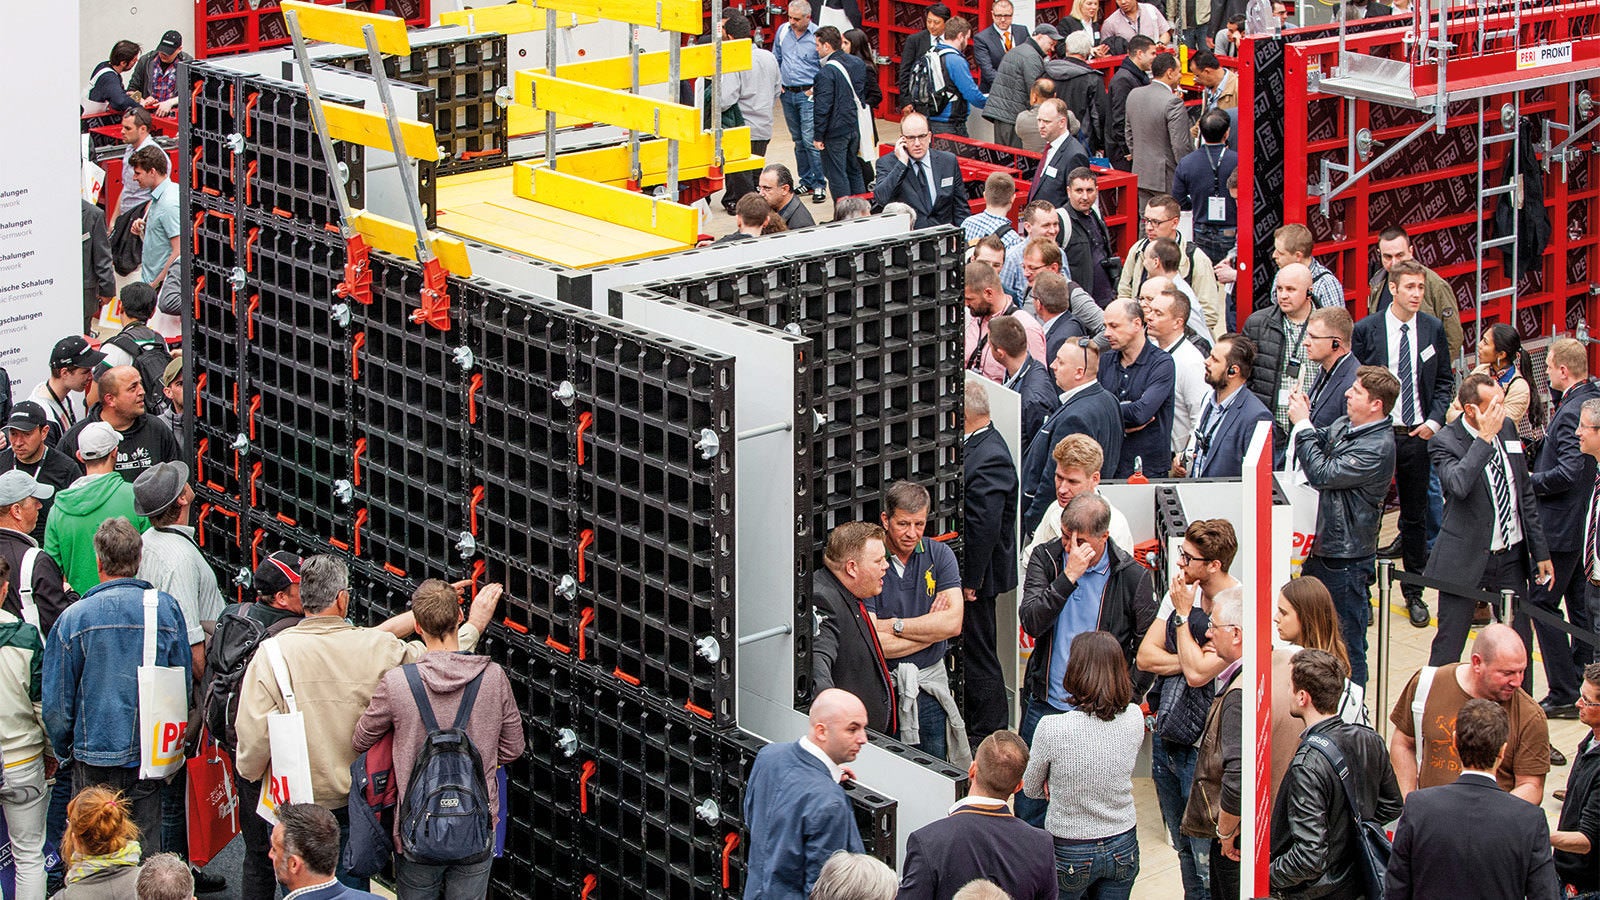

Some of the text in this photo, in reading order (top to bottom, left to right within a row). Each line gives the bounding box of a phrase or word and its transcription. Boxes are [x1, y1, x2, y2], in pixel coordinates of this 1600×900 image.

[220, 27, 238, 44] PERI
[1257, 40, 1280, 64] PERI
[1520, 45, 1570, 63] PERI PROKIT
[1261, 125, 1279, 157] PERI
[1436, 147, 1456, 169] PERI
[1369, 192, 1390, 218] PERI
[1425, 192, 1446, 217] PERI
[1256, 210, 1279, 236] PERI
[21, 278, 54, 289] Schalung
[8, 290, 44, 302] Formwork
[1520, 308, 1533, 332] PER
